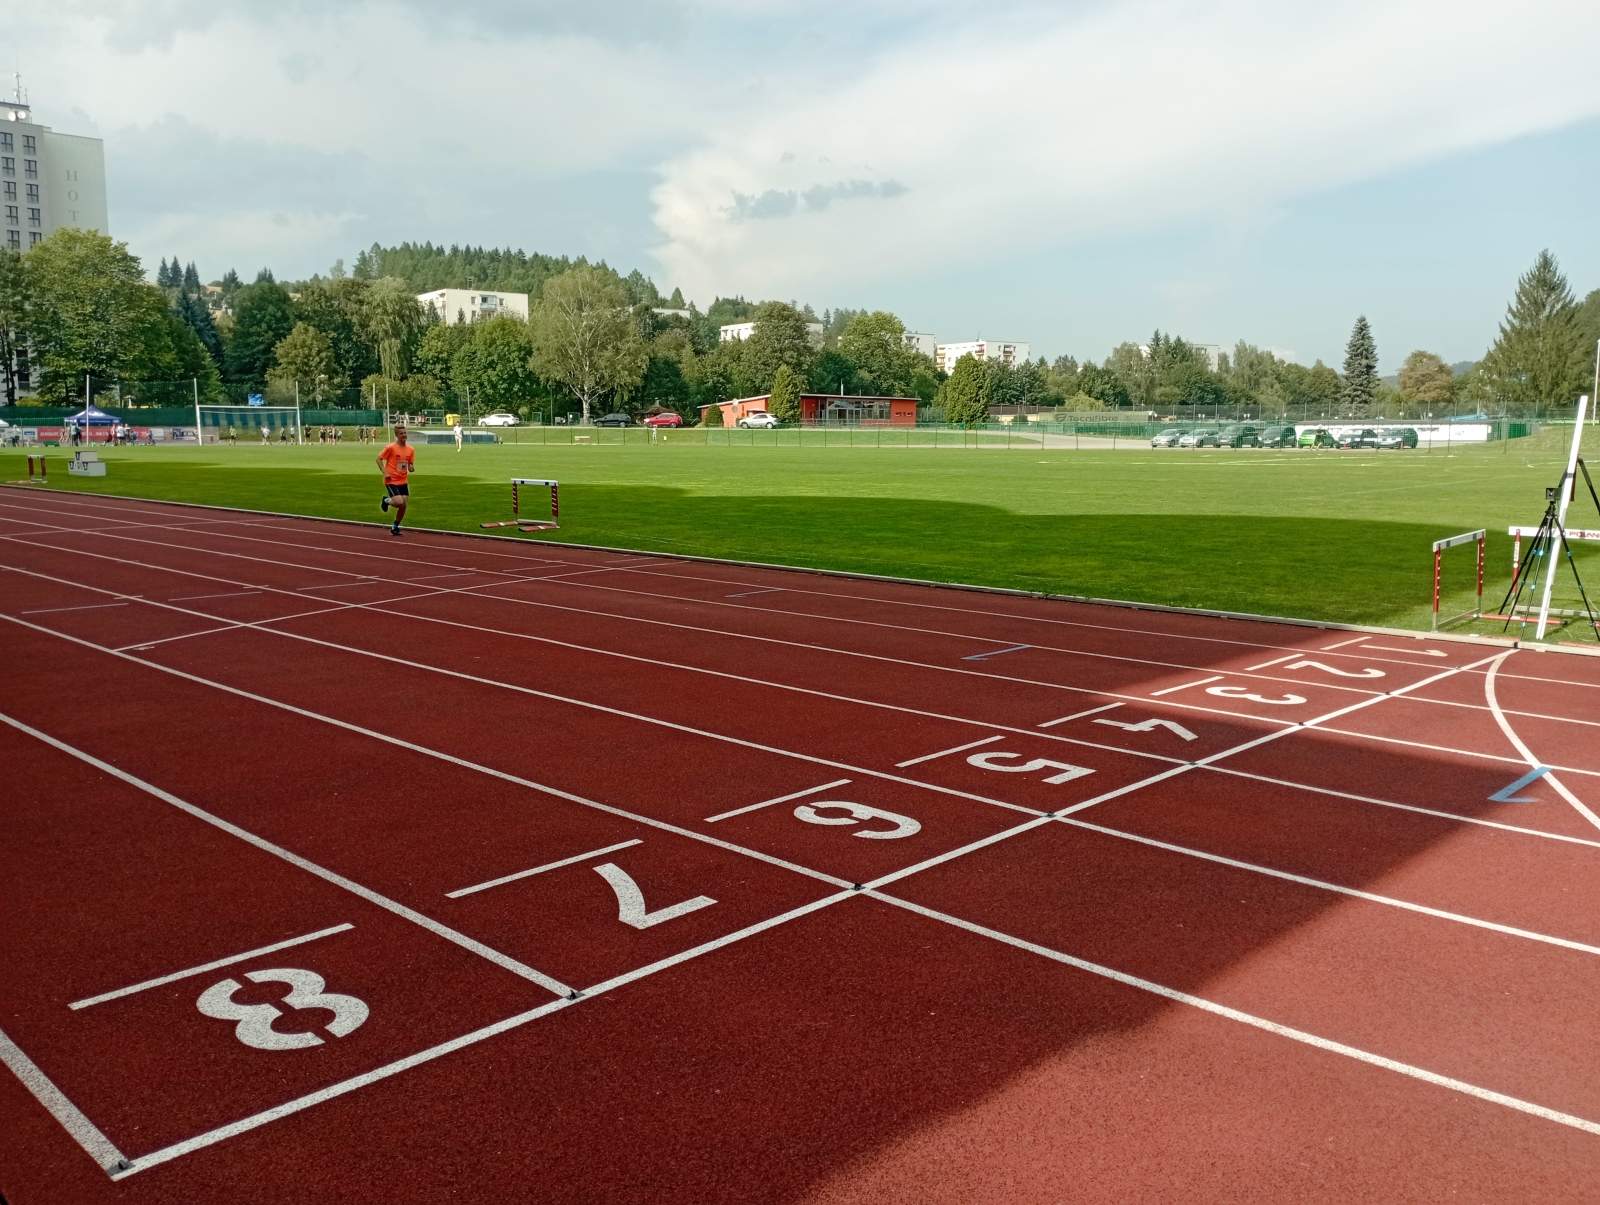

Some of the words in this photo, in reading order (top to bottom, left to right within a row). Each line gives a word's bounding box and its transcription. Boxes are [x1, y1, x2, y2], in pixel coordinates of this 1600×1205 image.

[66, 169, 80, 222] HOT
[1283, 659, 1387, 680] 2
[1205, 685, 1309, 706] 3
[1091, 718, 1199, 742] 4
[966, 752, 1098, 785] 5
[593, 862, 719, 930] 7
[196, 967, 370, 1051] 8
